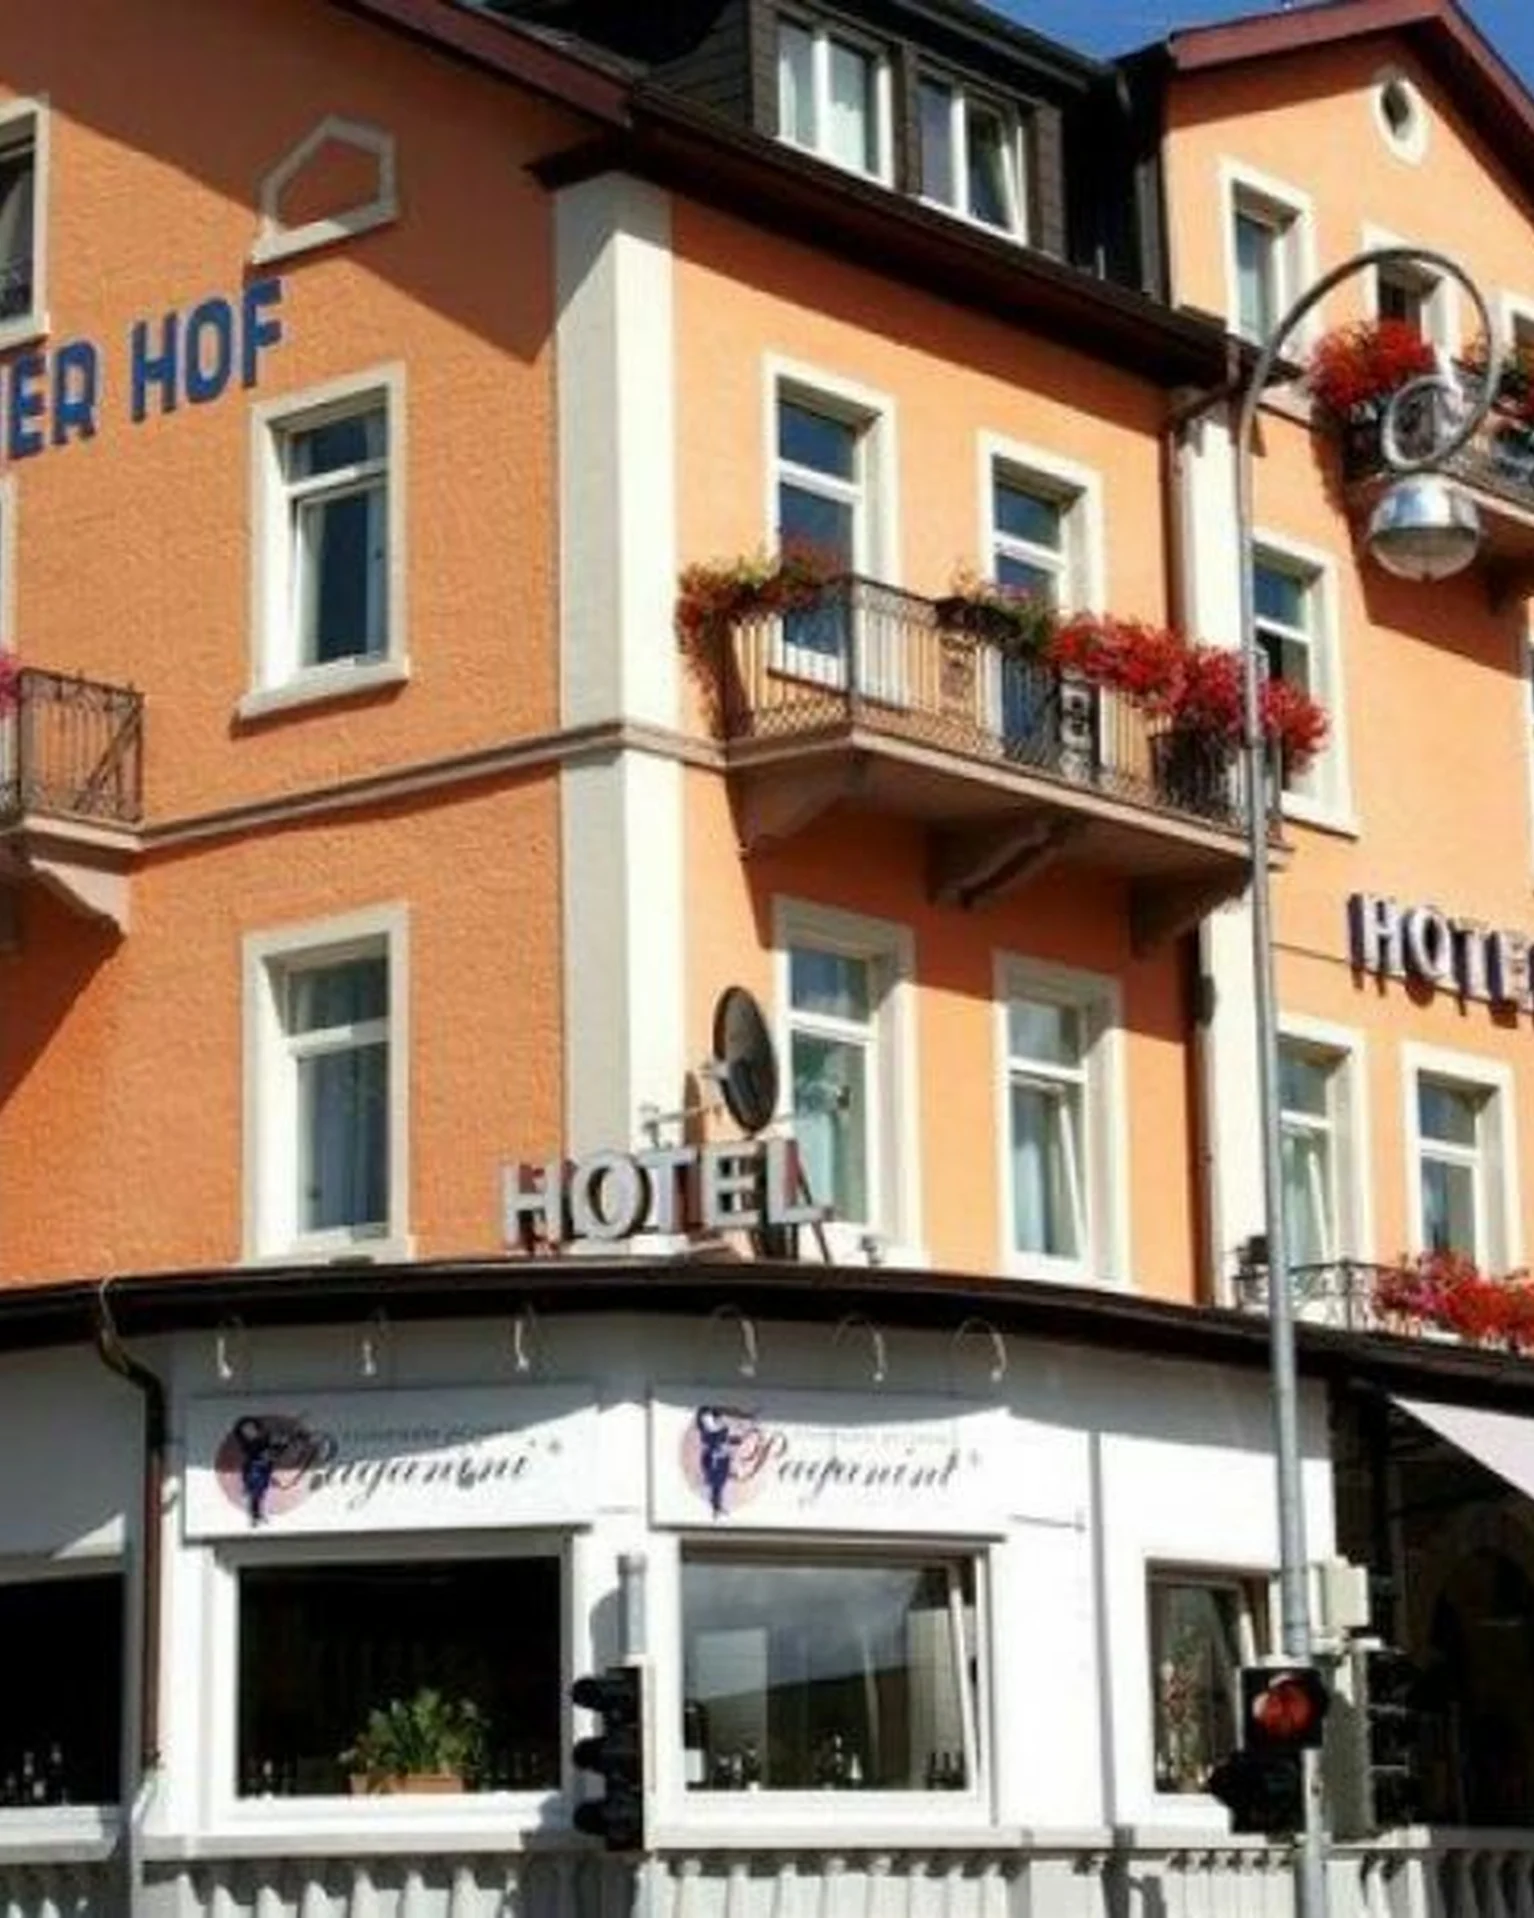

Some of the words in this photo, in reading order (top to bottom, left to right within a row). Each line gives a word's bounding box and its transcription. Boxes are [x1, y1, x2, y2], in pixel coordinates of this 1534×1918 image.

[130, 277, 283, 423] HOF
[1347, 893, 1534, 1006] HOTE
[502, 1137, 834, 1248] HOTEL
